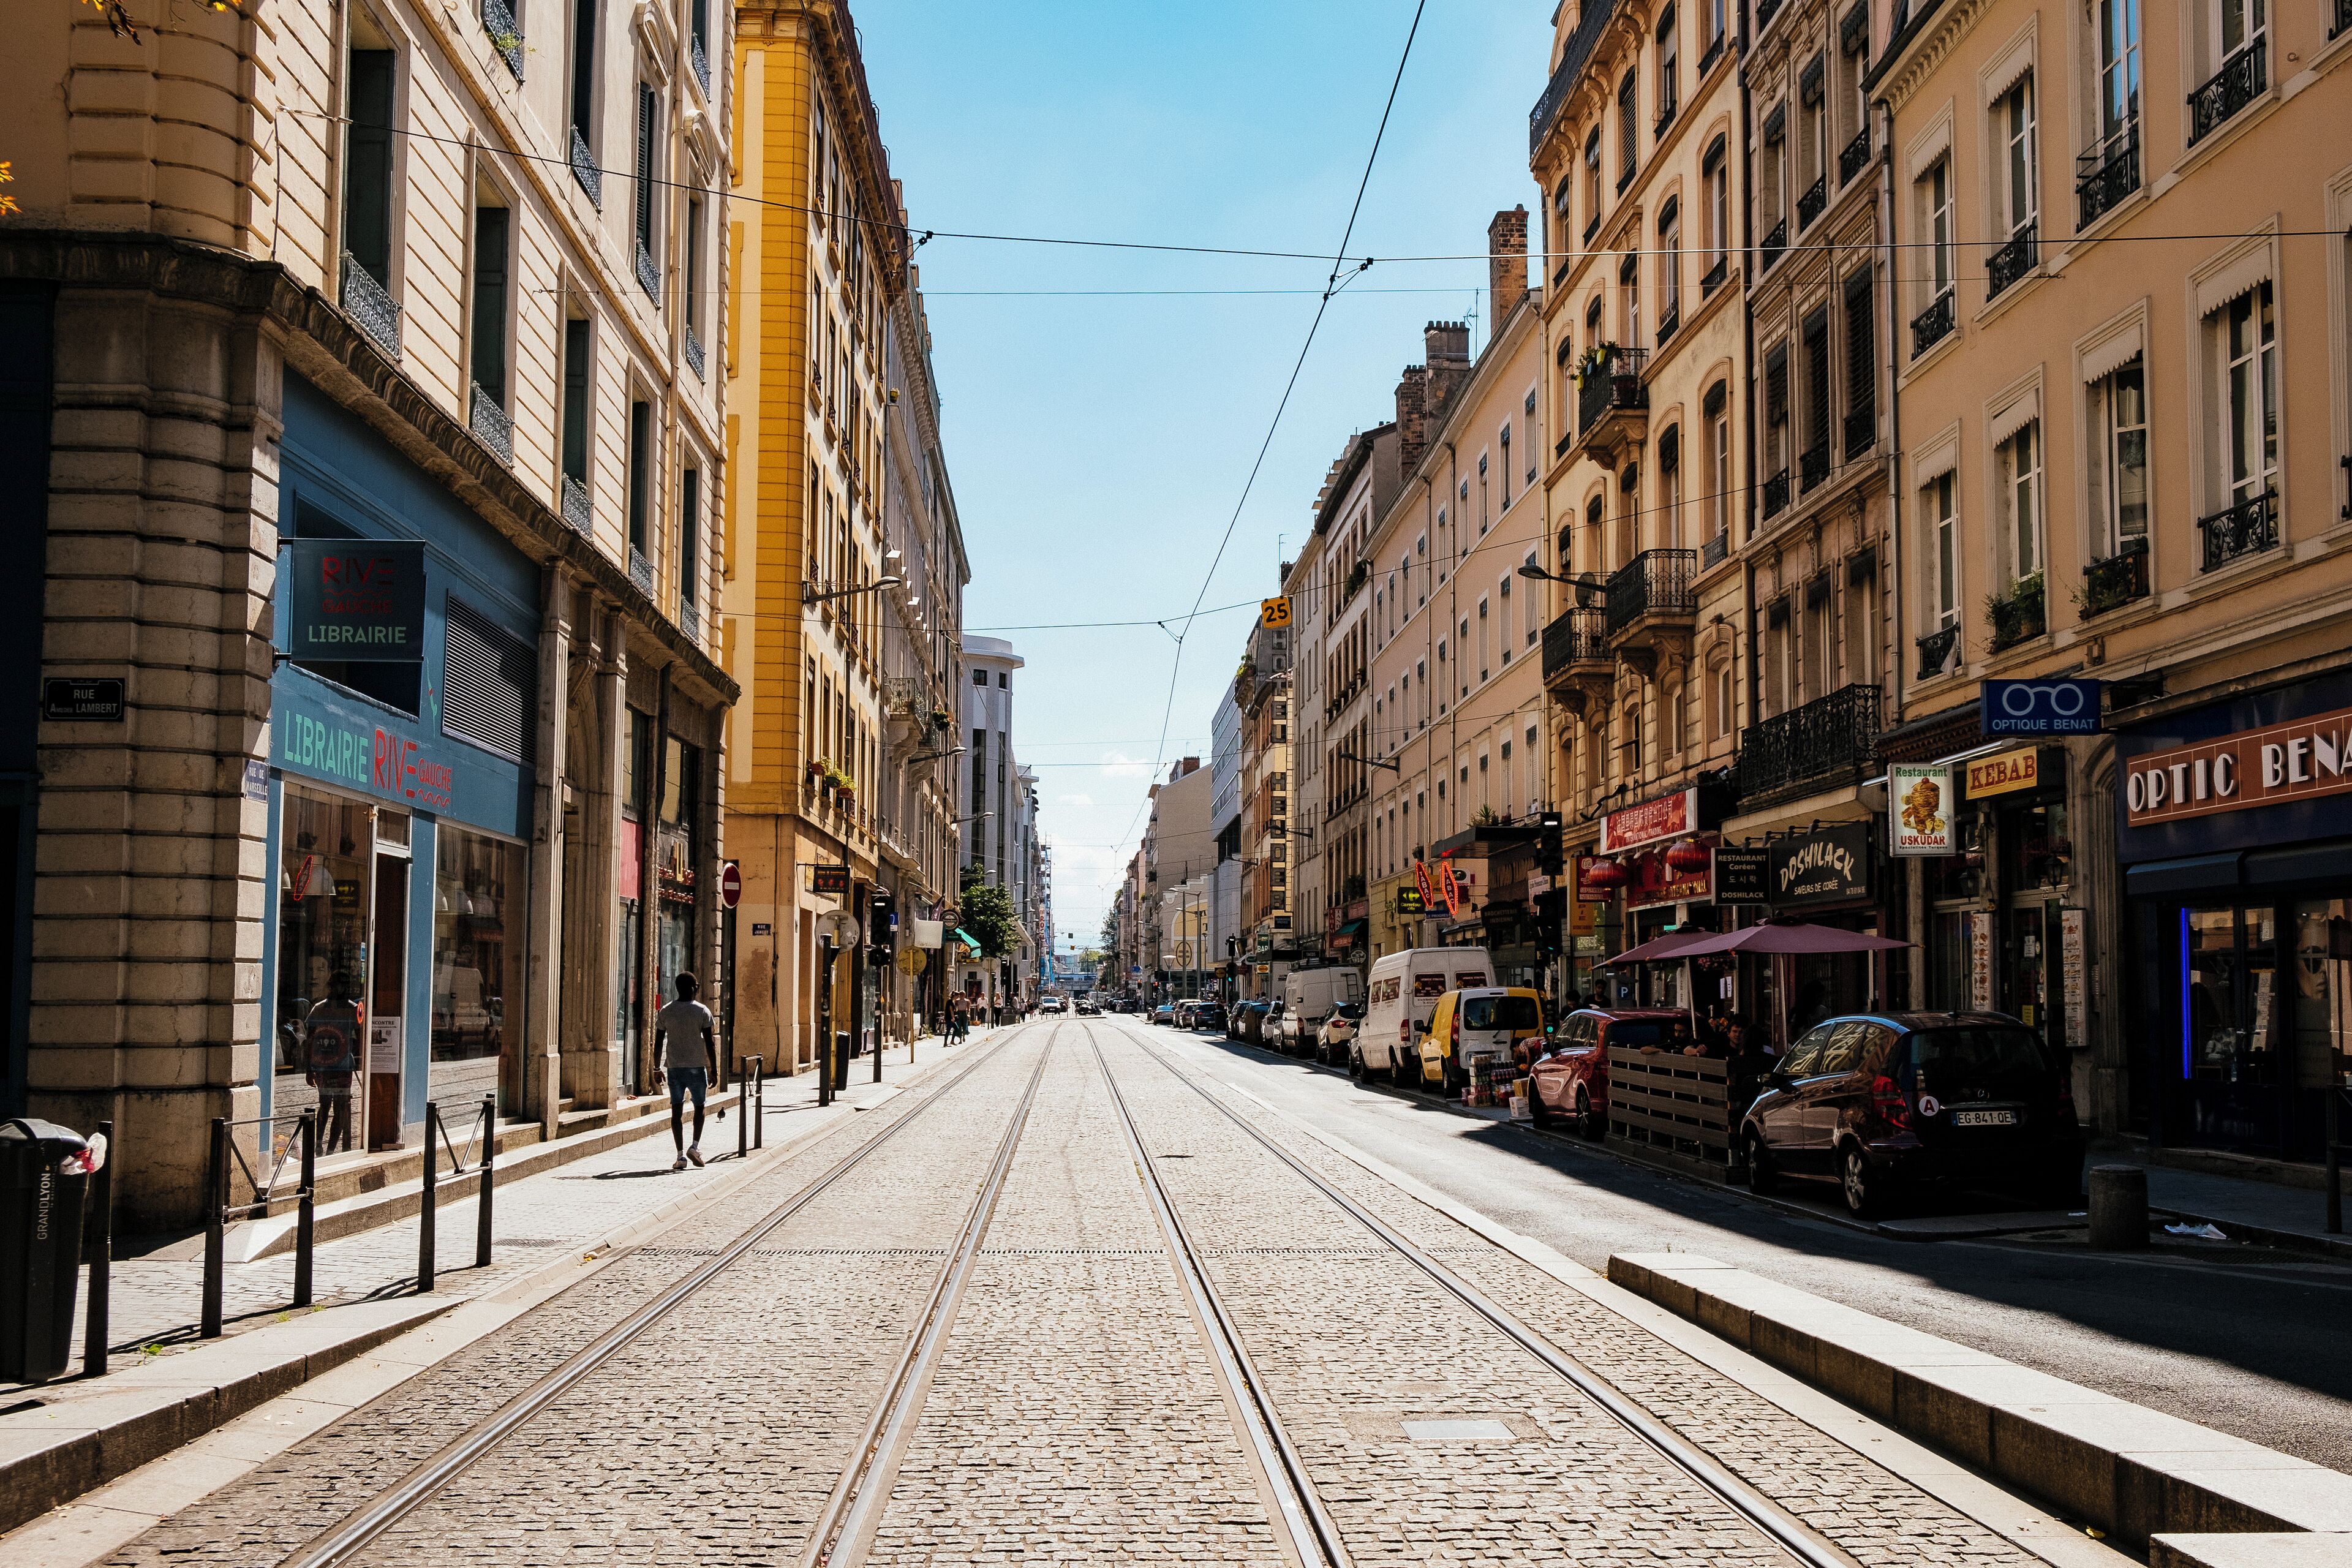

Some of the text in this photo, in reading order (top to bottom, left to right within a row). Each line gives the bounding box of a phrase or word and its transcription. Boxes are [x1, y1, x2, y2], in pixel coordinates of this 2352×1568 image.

[323, 557, 393, 586] RIVE
[323, 599, 393, 614] GAUCHE
[1264, 603, 1288, 623] 25
[309, 625, 407, 643] LIBRAIRIE
[74, 689, 94, 699] RUE
[76, 703, 118, 713] LAMBERT
[1992, 719, 2095, 730] OPTIQUE BENAT
[284, 710, 452, 799] LIBRAIRIE RIVE GAUCHE
[258, 769, 264, 779] DE
[1896, 767, 1947, 777] Restaurant
[1970, 755, 2035, 791] KEBAB
[246, 781, 268, 796] MARSEILLE
[2127, 753, 2235, 812] OPTIC
[1901, 835, 1945, 845] USKUDAR
[1780, 842, 1854, 892] DOSHILACK
[1419, 871, 1430, 899] TABAC
[1444, 872, 1455, 904] TABAC
[1668, 879, 1707, 897] INTERNAONAL
[1794, 877, 1838, 895] SAVEURS DE CORÉE
[1621, 987, 1628, 997] P
[1924, 1099, 1936, 1112] A
[37, 1173, 51, 1240] GRANDLYON
